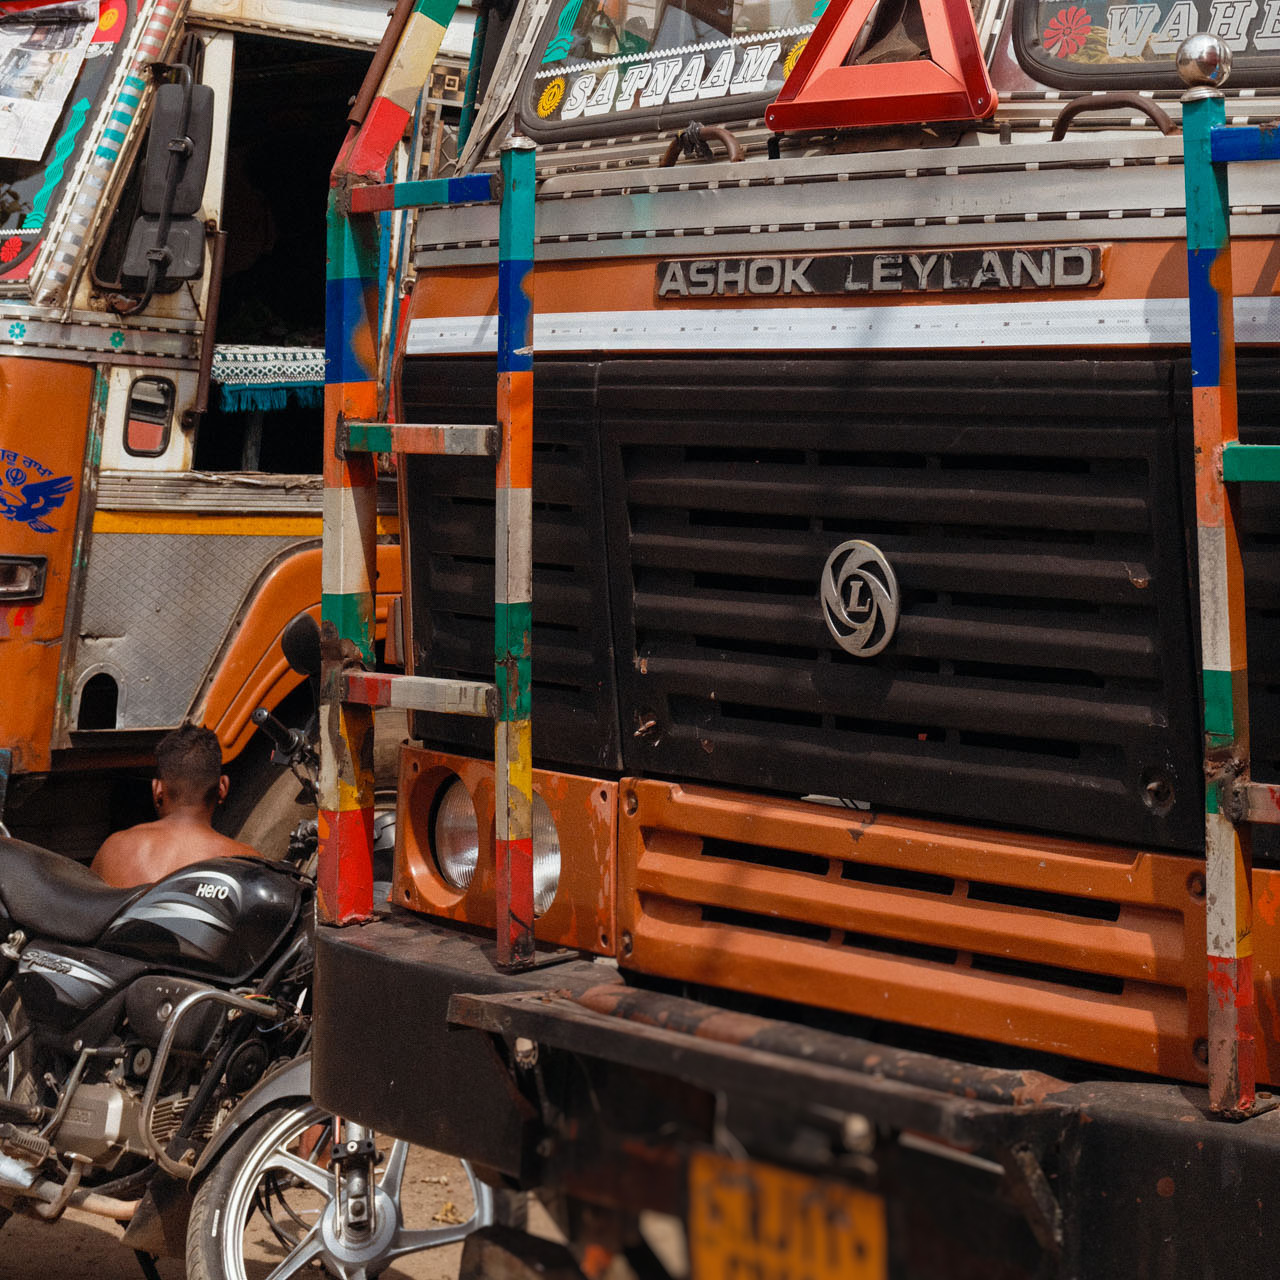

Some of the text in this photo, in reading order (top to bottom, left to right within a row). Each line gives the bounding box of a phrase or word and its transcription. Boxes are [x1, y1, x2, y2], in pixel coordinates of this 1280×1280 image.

[561, 42, 782, 121] SATNAAM
[658, 246, 1093, 297] ASHOK LEYLAND
[195, 883, 230, 900] Hero
